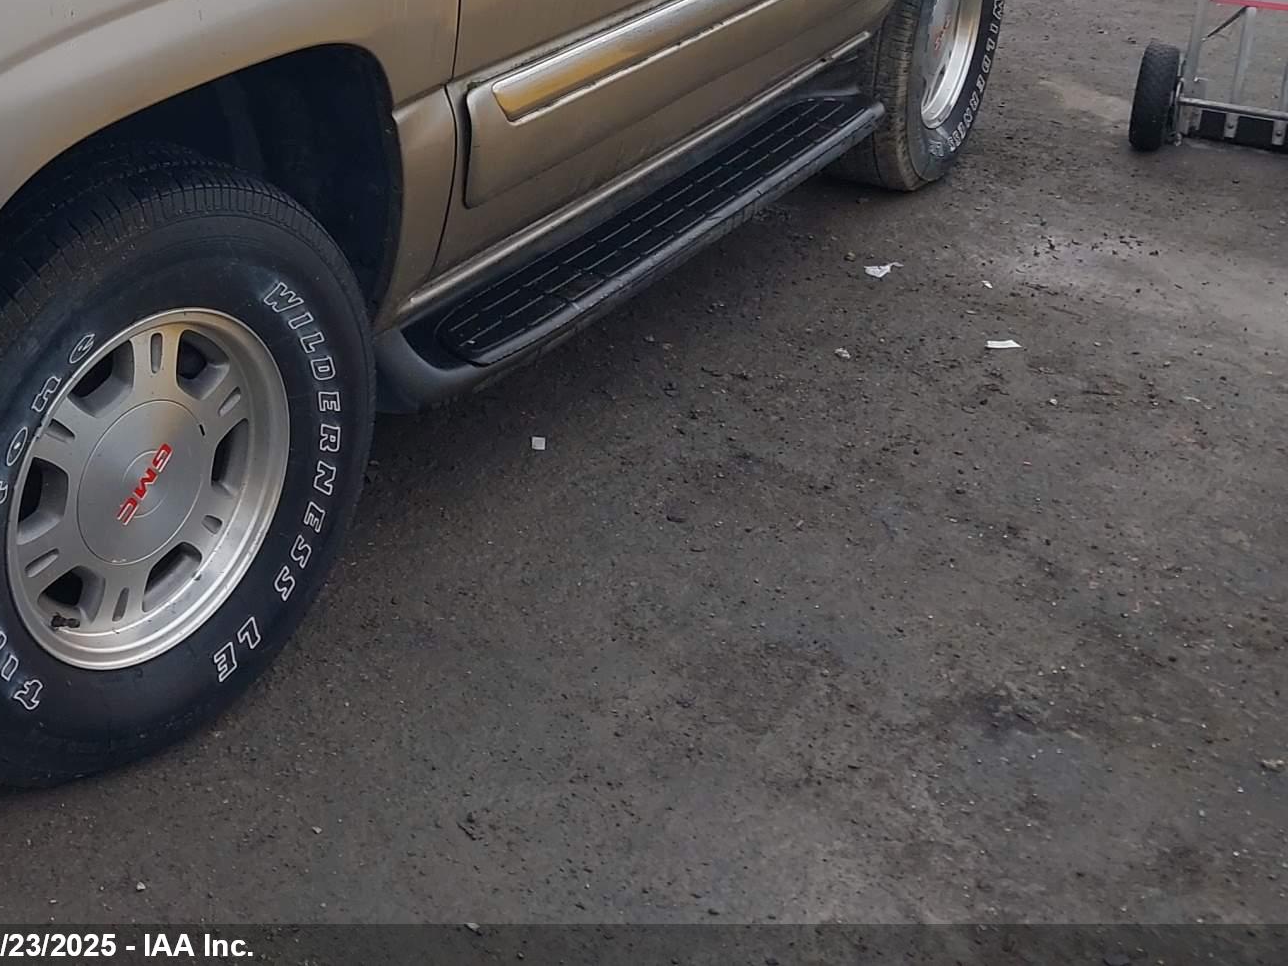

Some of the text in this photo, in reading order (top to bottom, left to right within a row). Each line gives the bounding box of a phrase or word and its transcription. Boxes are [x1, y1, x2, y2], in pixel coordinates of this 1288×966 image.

[117, 443, 173, 526] GMC
[214, 281, 341, 682] WILDERNESS LE
